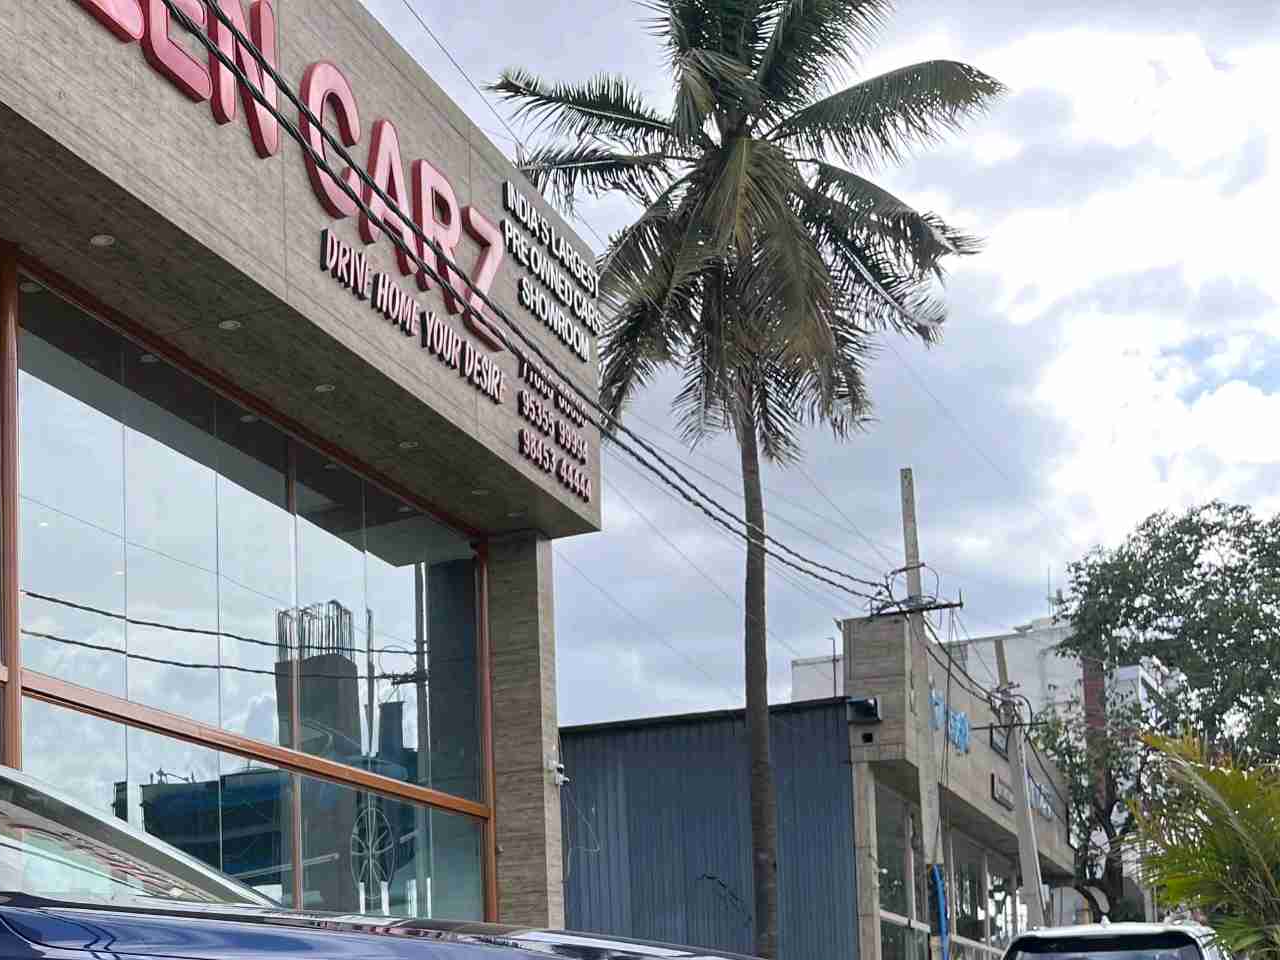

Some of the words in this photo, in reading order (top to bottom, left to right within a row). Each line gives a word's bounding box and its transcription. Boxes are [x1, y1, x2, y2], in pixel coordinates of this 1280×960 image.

[71, 0, 278, 158] EN
[299, 63, 504, 351] CARZ
[502, 218, 531, 266] PRE
[530, 245, 573, 307] OWNED
[573, 290, 602, 336] CARS
[505, 180, 550, 246] INDIA'S
[550, 225, 600, 299] LARGEST
[322, 229, 371, 299] DRIVE
[374, 272, 418, 335] HOME
[422, 311, 461, 369] YOUR
[461, 341, 505, 403] DESIRE
[520, 276, 591, 362] SHOWROOM
[519, 390, 555, 436] 95355
[520, 429, 556, 473] 98453
